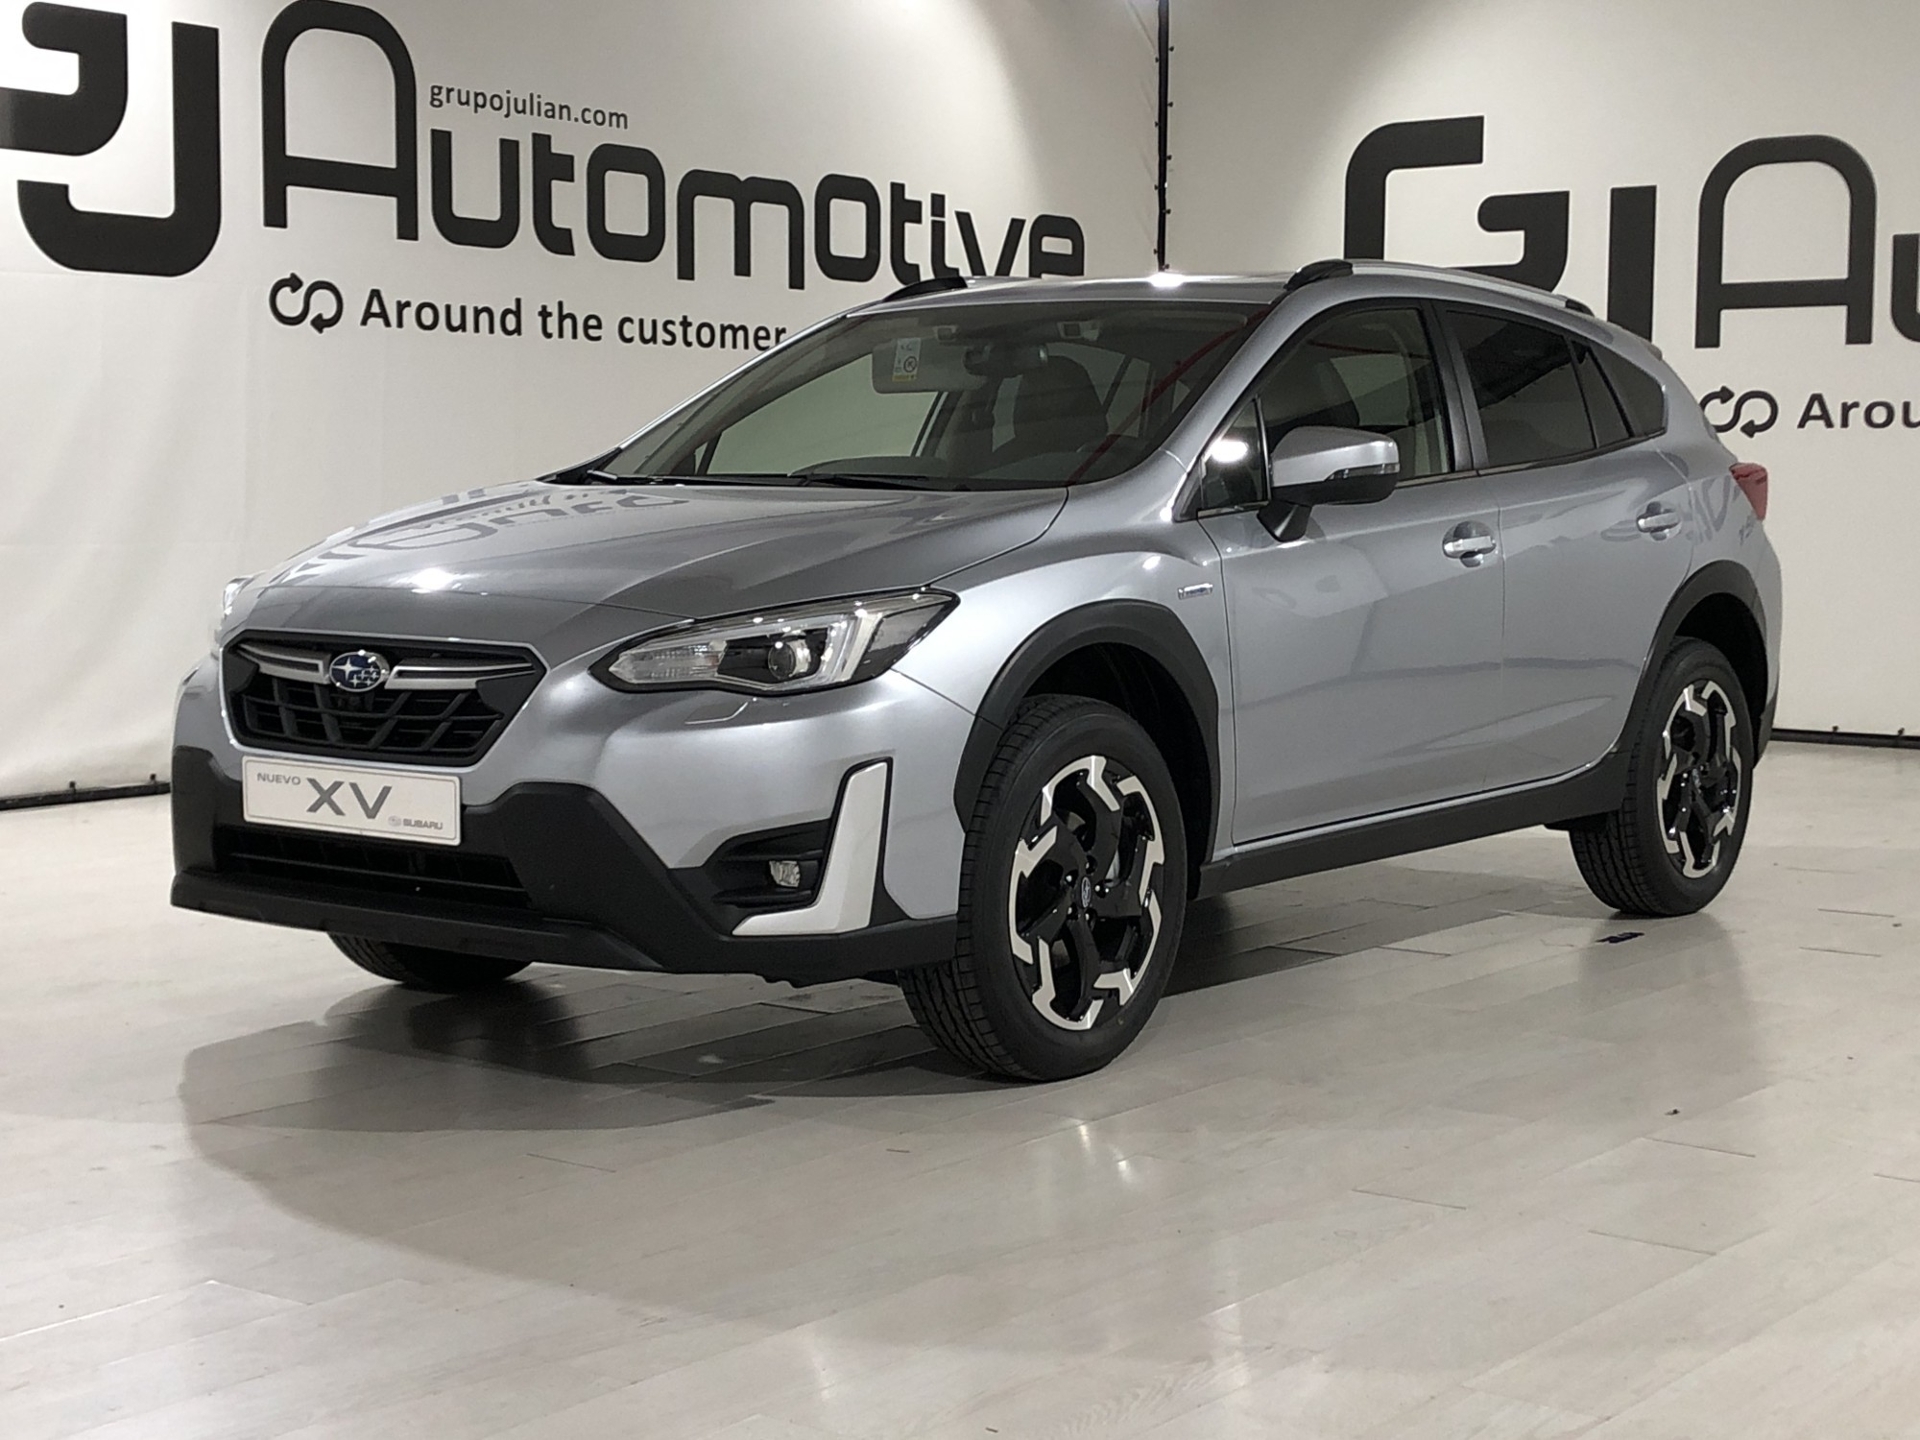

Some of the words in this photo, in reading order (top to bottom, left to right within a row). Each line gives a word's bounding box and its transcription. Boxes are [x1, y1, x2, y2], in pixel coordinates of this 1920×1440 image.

[429, 84, 628, 130] grupojulian.com
[261, 0, 1085, 291] Automotive
[360, 288, 522, 337] Around
[537, 300, 603, 342] the
[617, 316, 787, 352] customer
[256, 772, 301, 785] NUEVO
[306, 777, 393, 820] XV
[403, 818, 443, 831] SUBARU
